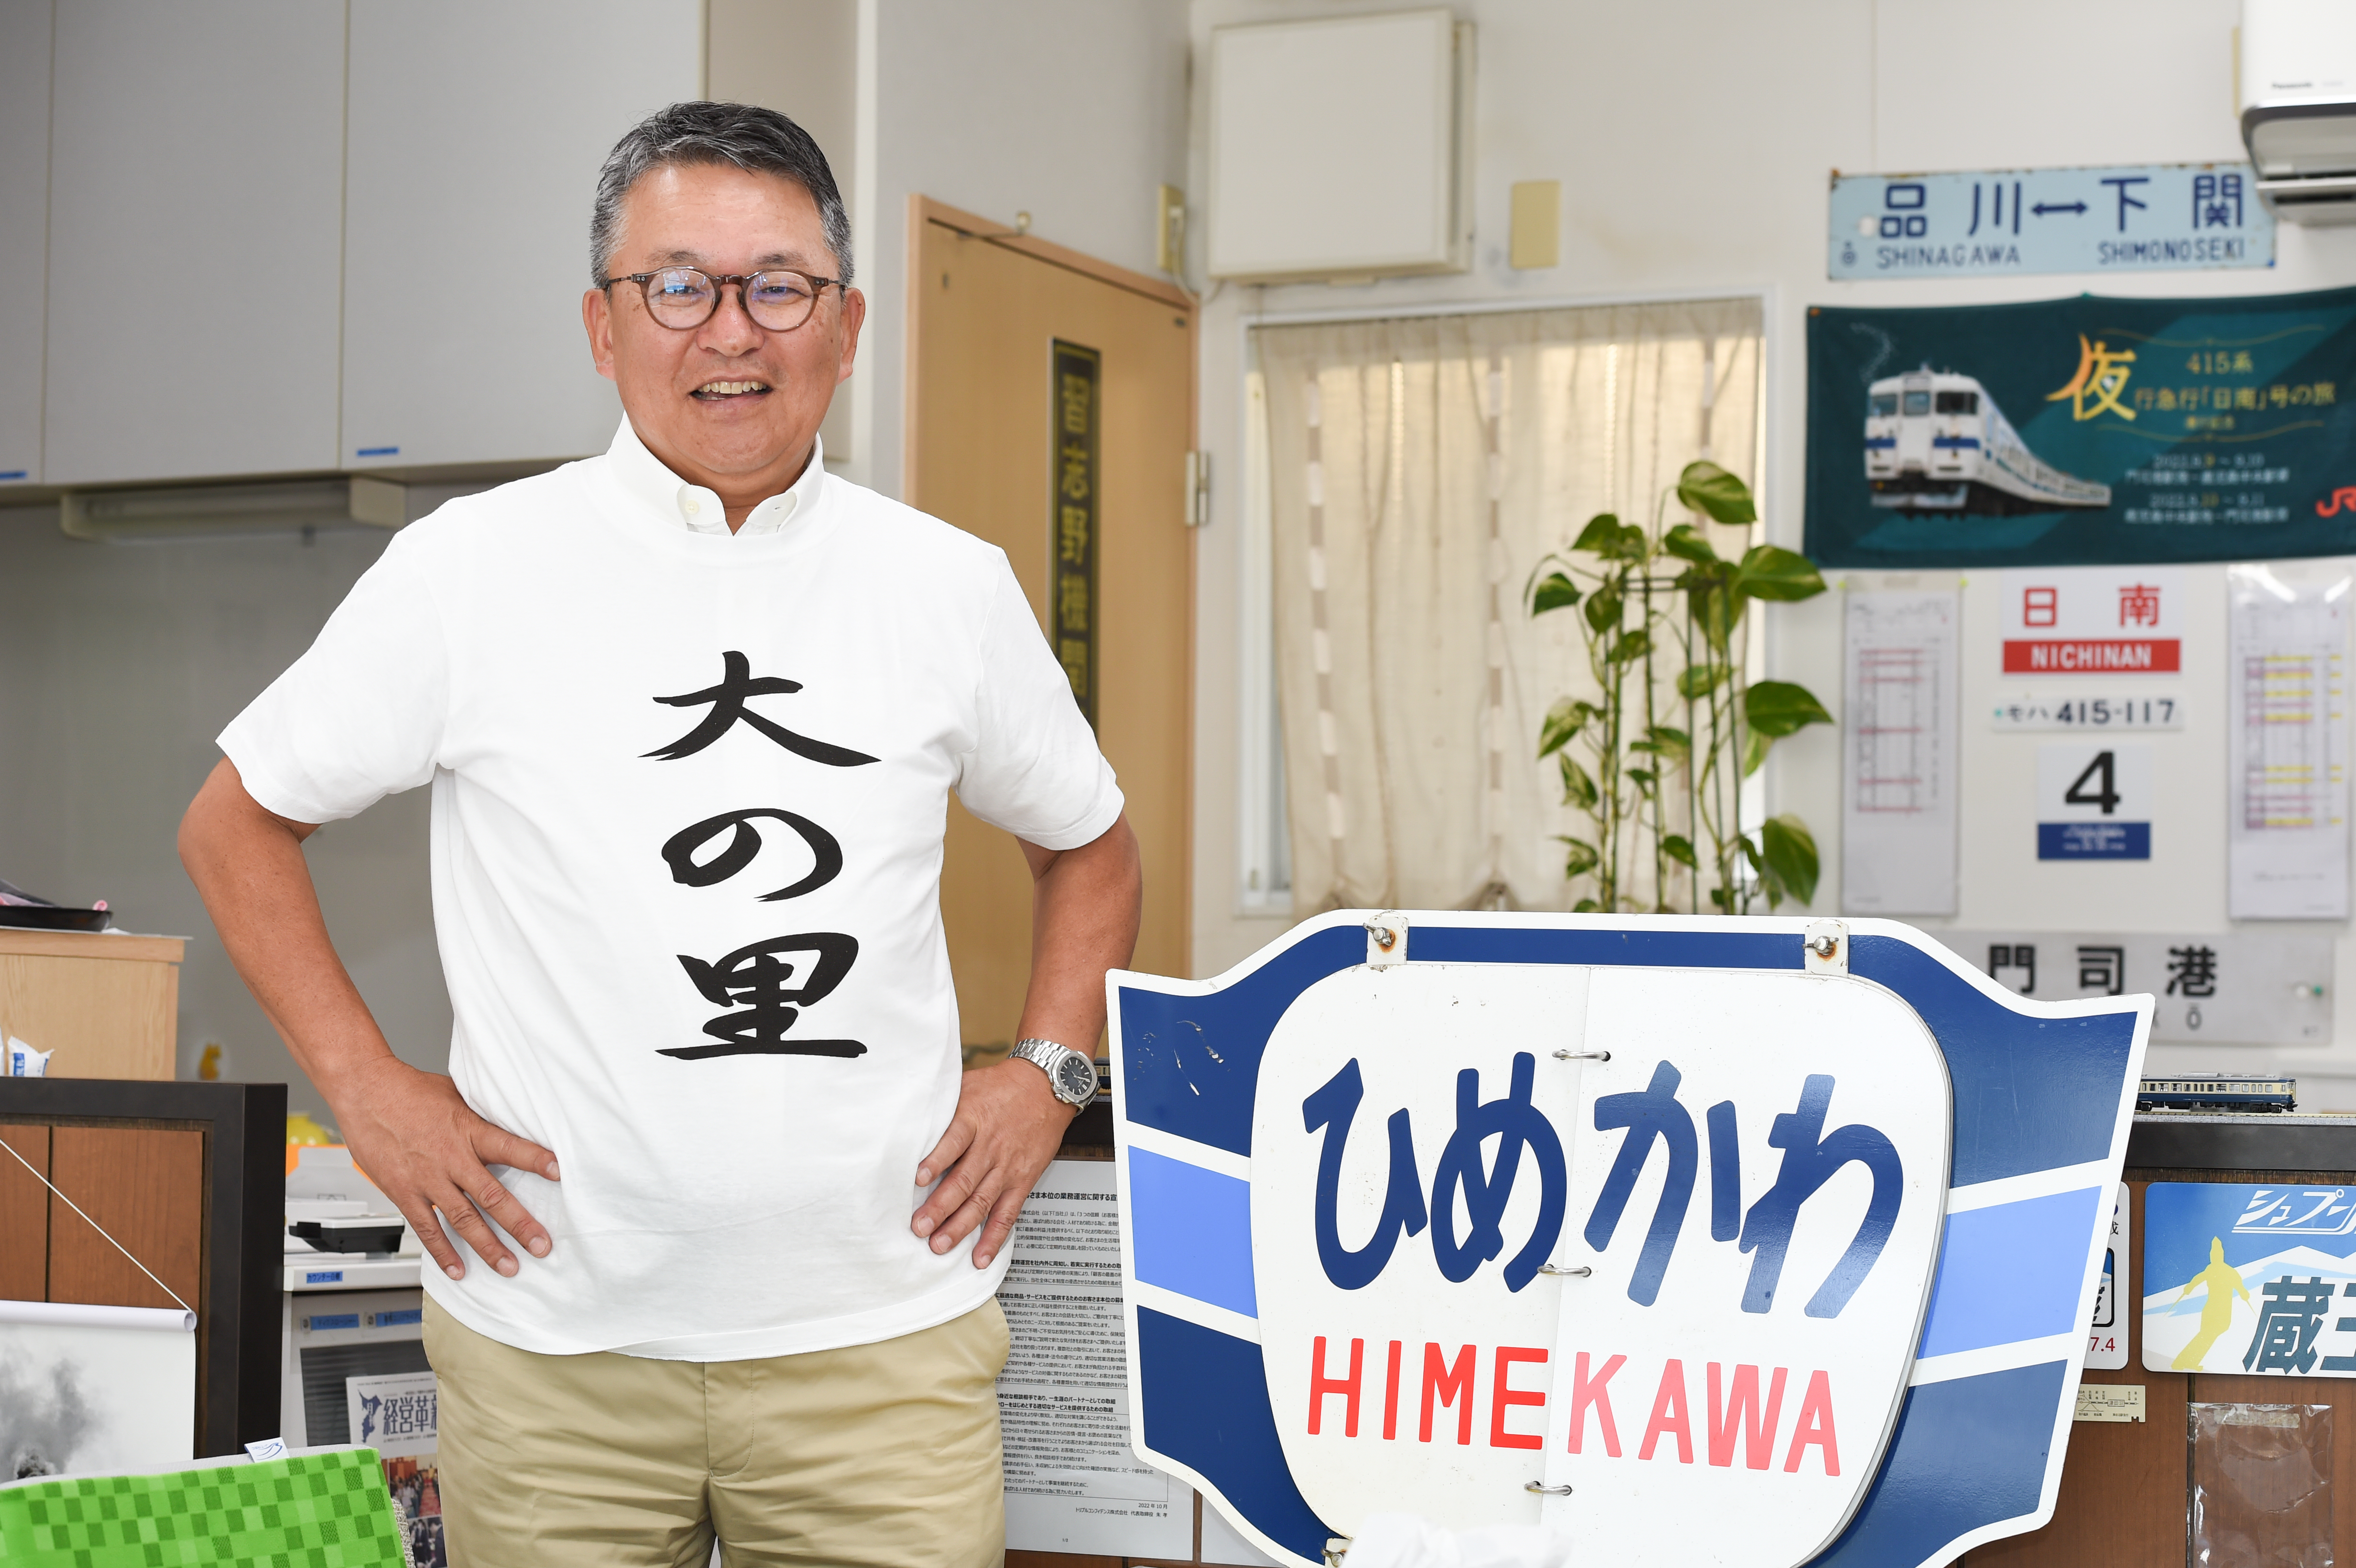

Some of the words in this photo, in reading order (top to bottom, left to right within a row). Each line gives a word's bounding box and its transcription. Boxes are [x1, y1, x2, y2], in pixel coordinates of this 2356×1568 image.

[1879, 182, 2022, 239] 品川
[2100, 173, 2243, 233] 下関
[1876, 244, 2021, 270] SHINAGAWA
[2098, 238, 2246, 265] SHIMONOSEKI
[2045, 332, 2138, 422] 夜
[2185, 351, 2253, 375] 415系
[2024, 584, 2161, 629] 日南
[2031, 643, 2151, 668] NICHINAN
[2057, 699, 2175, 725] 415-117
[2063, 750, 2121, 815] 4
[637, 650, 883, 1060] 大の里
[1988, 943, 2218, 999] 門司港
[1027, 1192, 1117, 1201] さま本位の業務運営に関する宣
[1302, 1051, 1904, 1319] ひめかわ
[2235, 1188, 2356, 1227] シュプー
[998, 1402, 1113, 1413] ローをはじめとする適切なサービスを提供するための取組
[1308, 1335, 1840, 1477] HIMEKAWA
